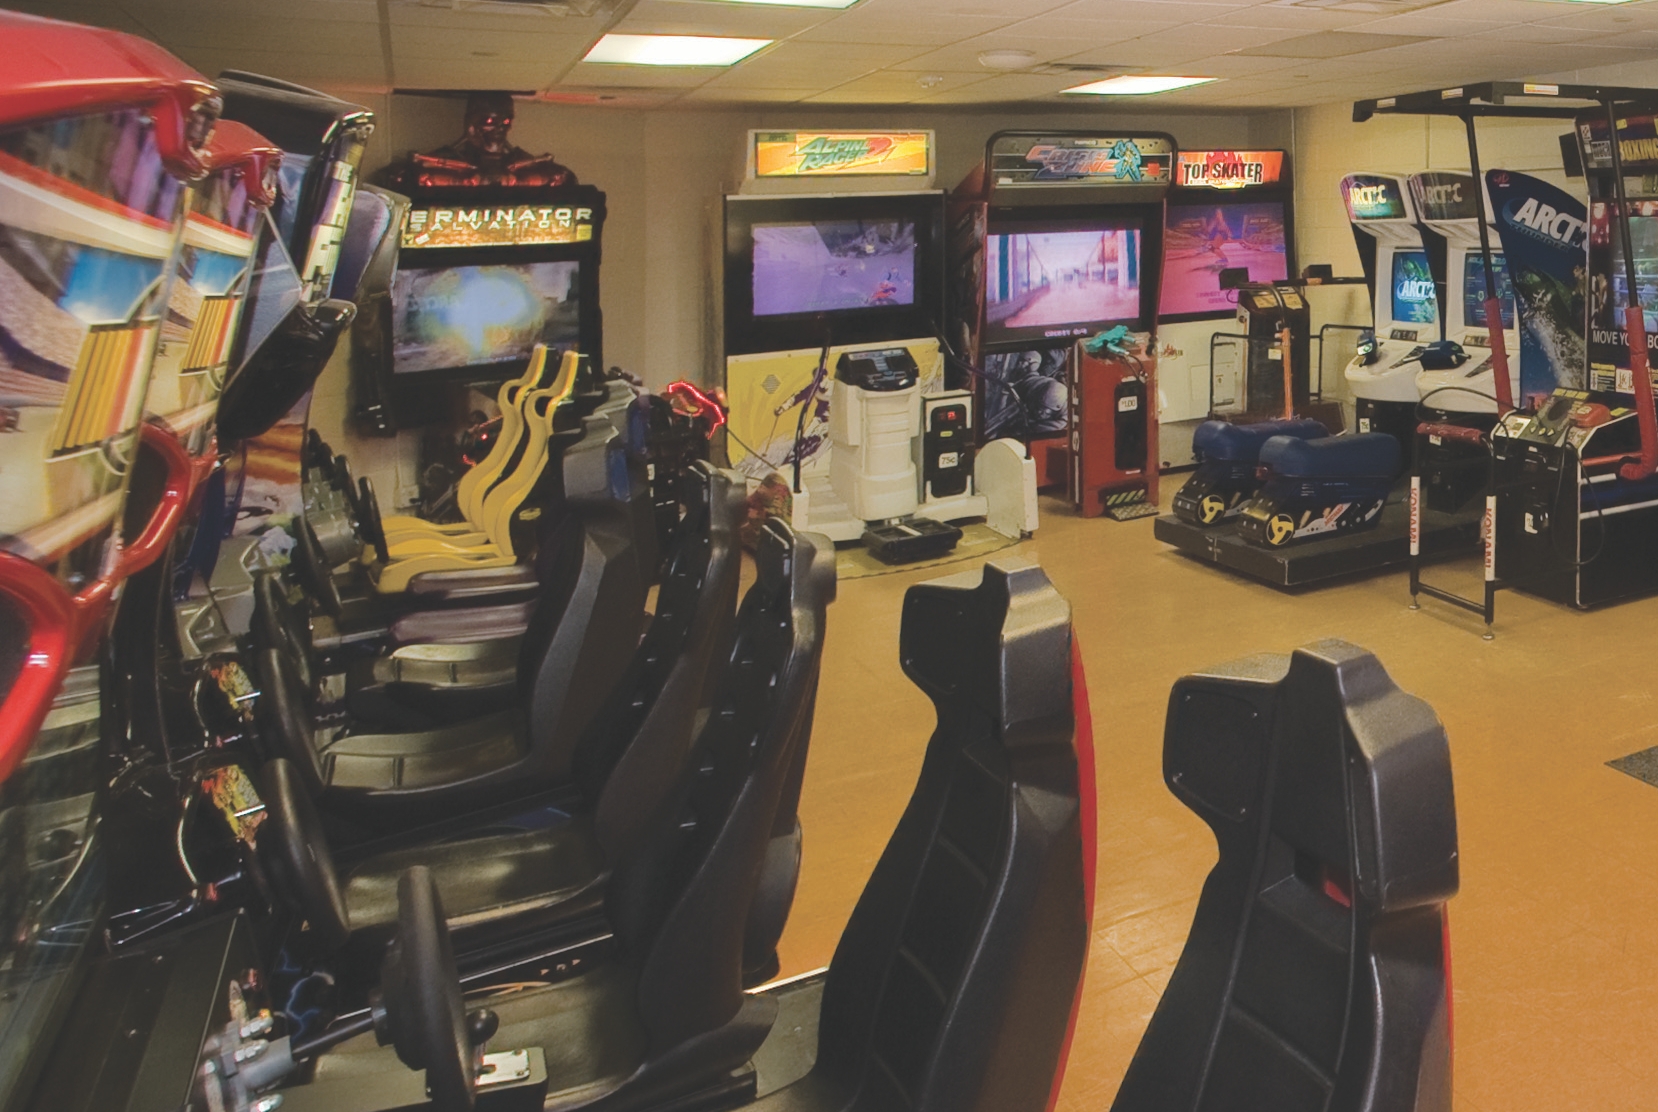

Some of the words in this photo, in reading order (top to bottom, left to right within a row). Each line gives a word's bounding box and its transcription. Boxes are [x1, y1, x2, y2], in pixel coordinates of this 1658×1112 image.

[1184, 163, 1209, 184] TOP
[1212, 162, 1263, 183] SKATER
[410, 208, 593, 223] ERMINATOR
[409, 220, 572, 232] SALVATION
[1592, 330, 1619, 345] MOVE
[1410, 488, 1418, 544] KONAMI
[1485, 508, 1493, 568] KONAMI
